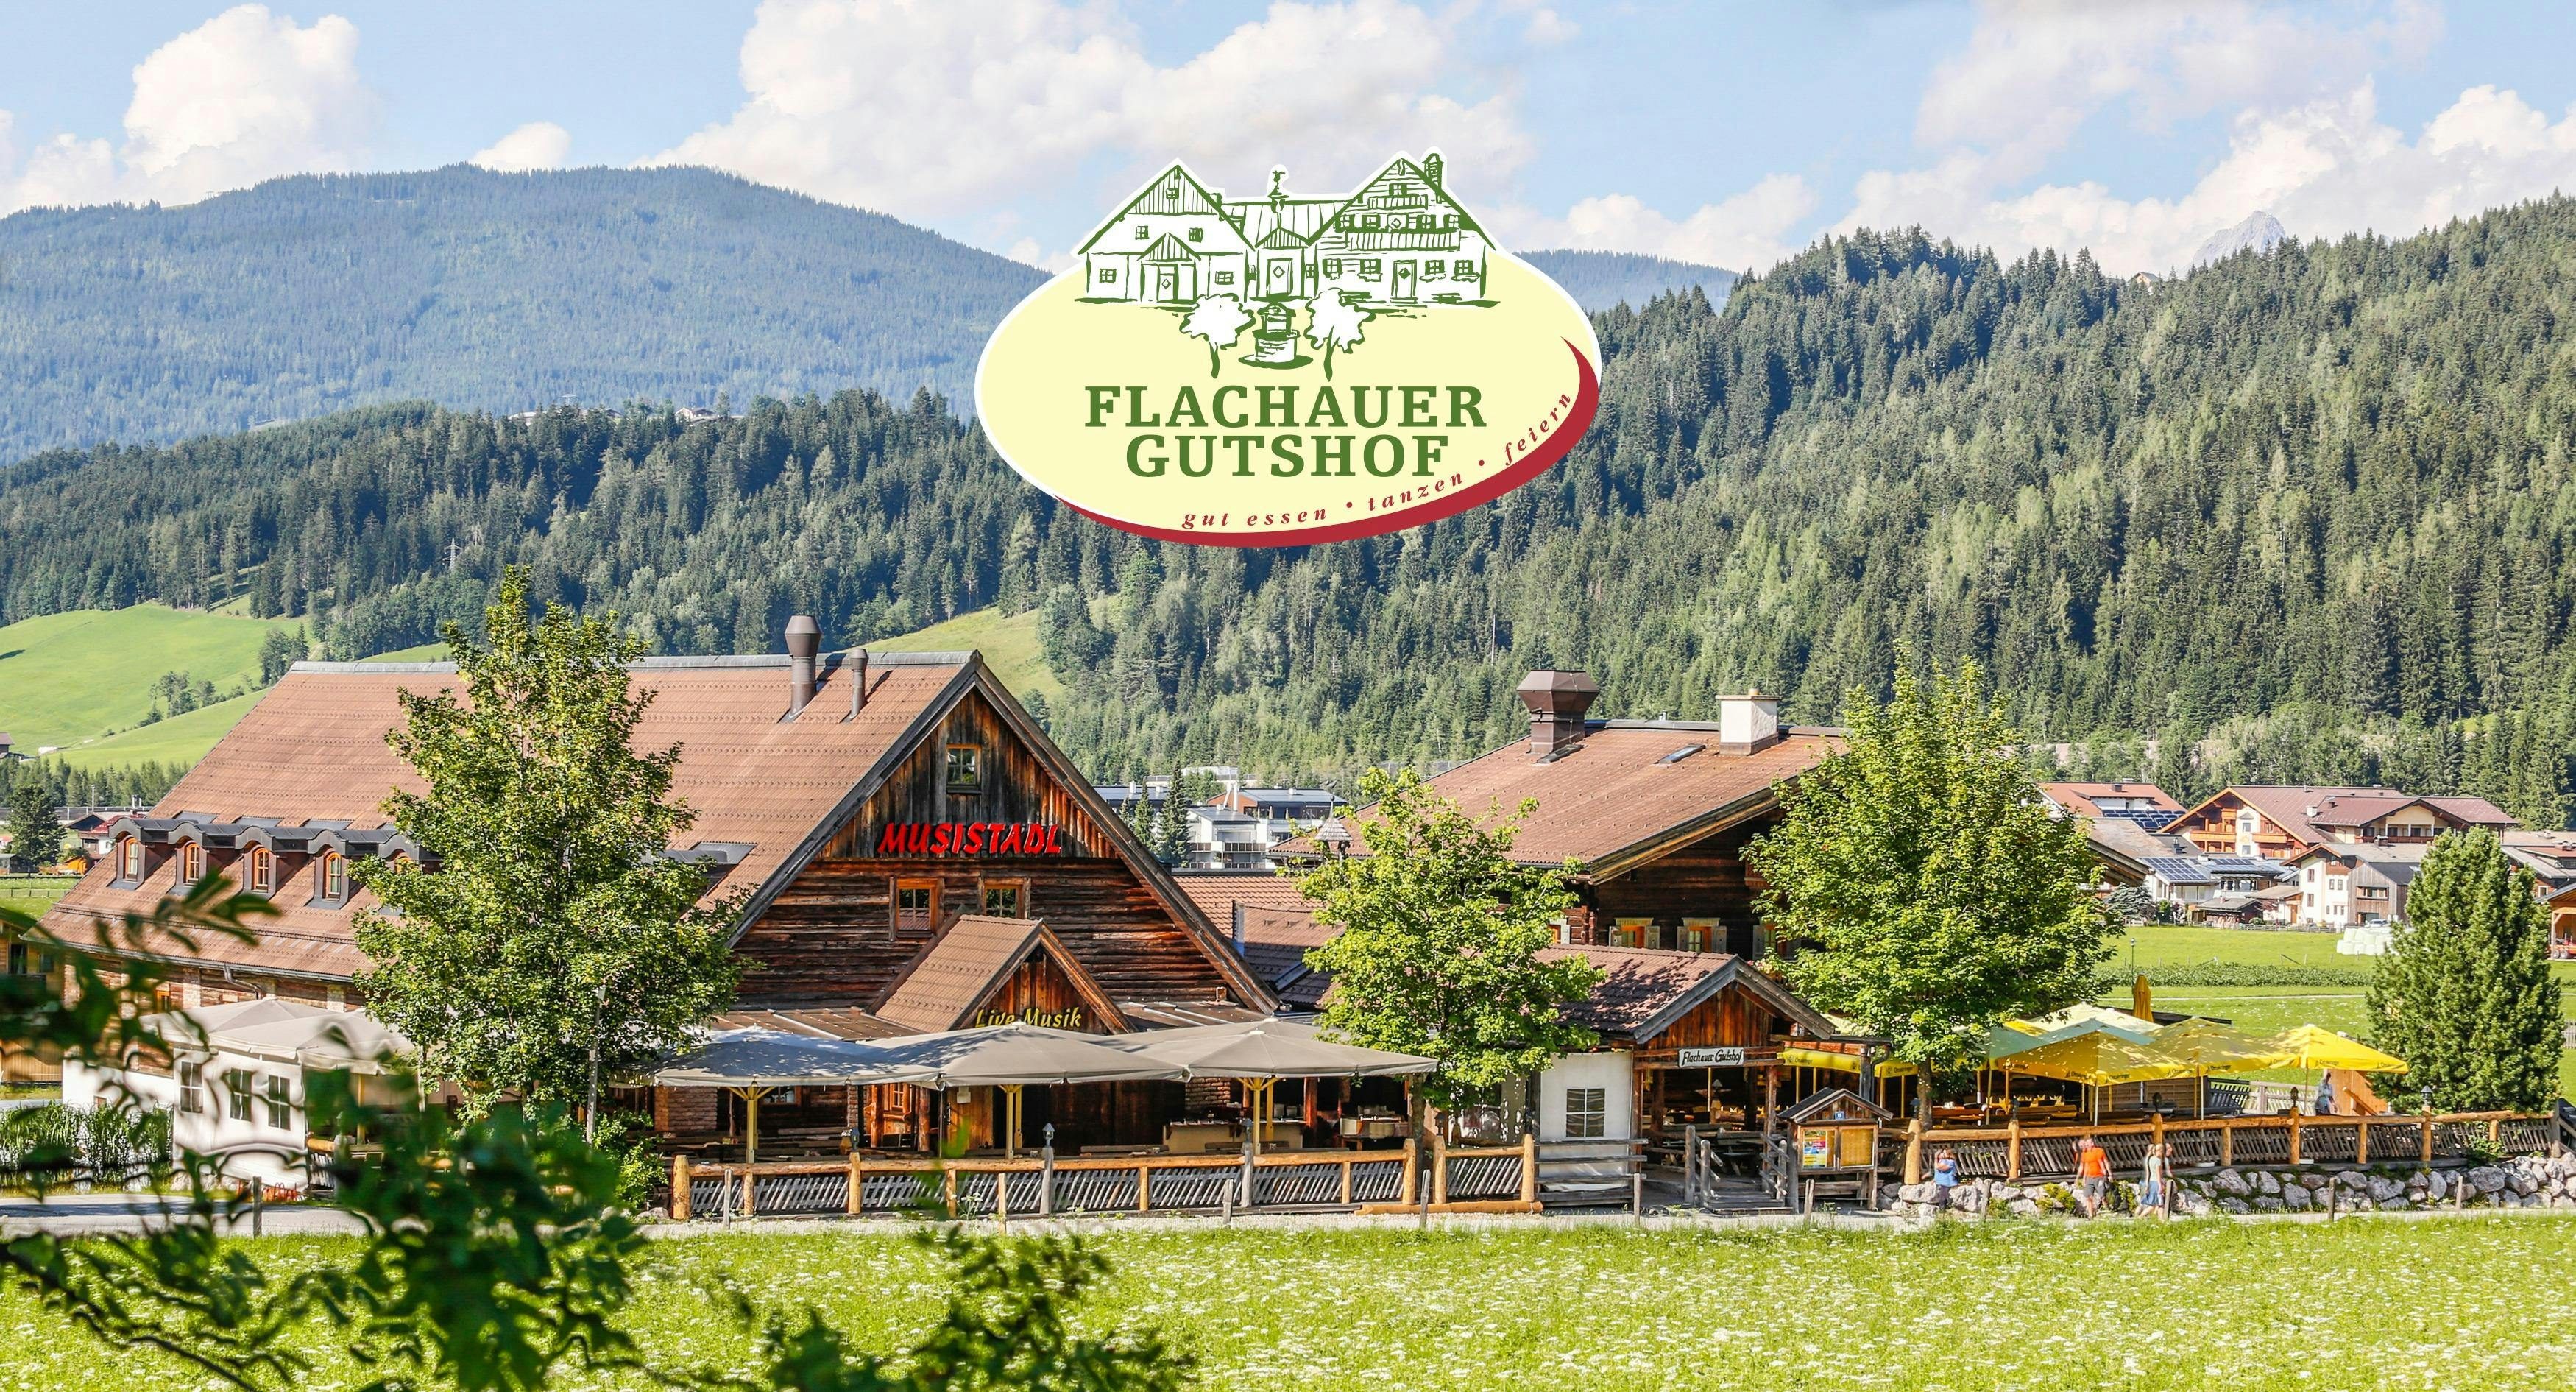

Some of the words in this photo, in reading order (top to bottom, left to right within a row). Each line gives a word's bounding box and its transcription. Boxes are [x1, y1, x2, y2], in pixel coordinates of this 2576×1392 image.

[877, 822, 1061, 855] MUSISTADL
[974, 1008, 1015, 1028] Live
[1024, 1006, 1082, 1028] Musik
[1681, 1050, 1714, 1066] Flachauer
[1714, 1048, 1744, 1066] Gutshof
